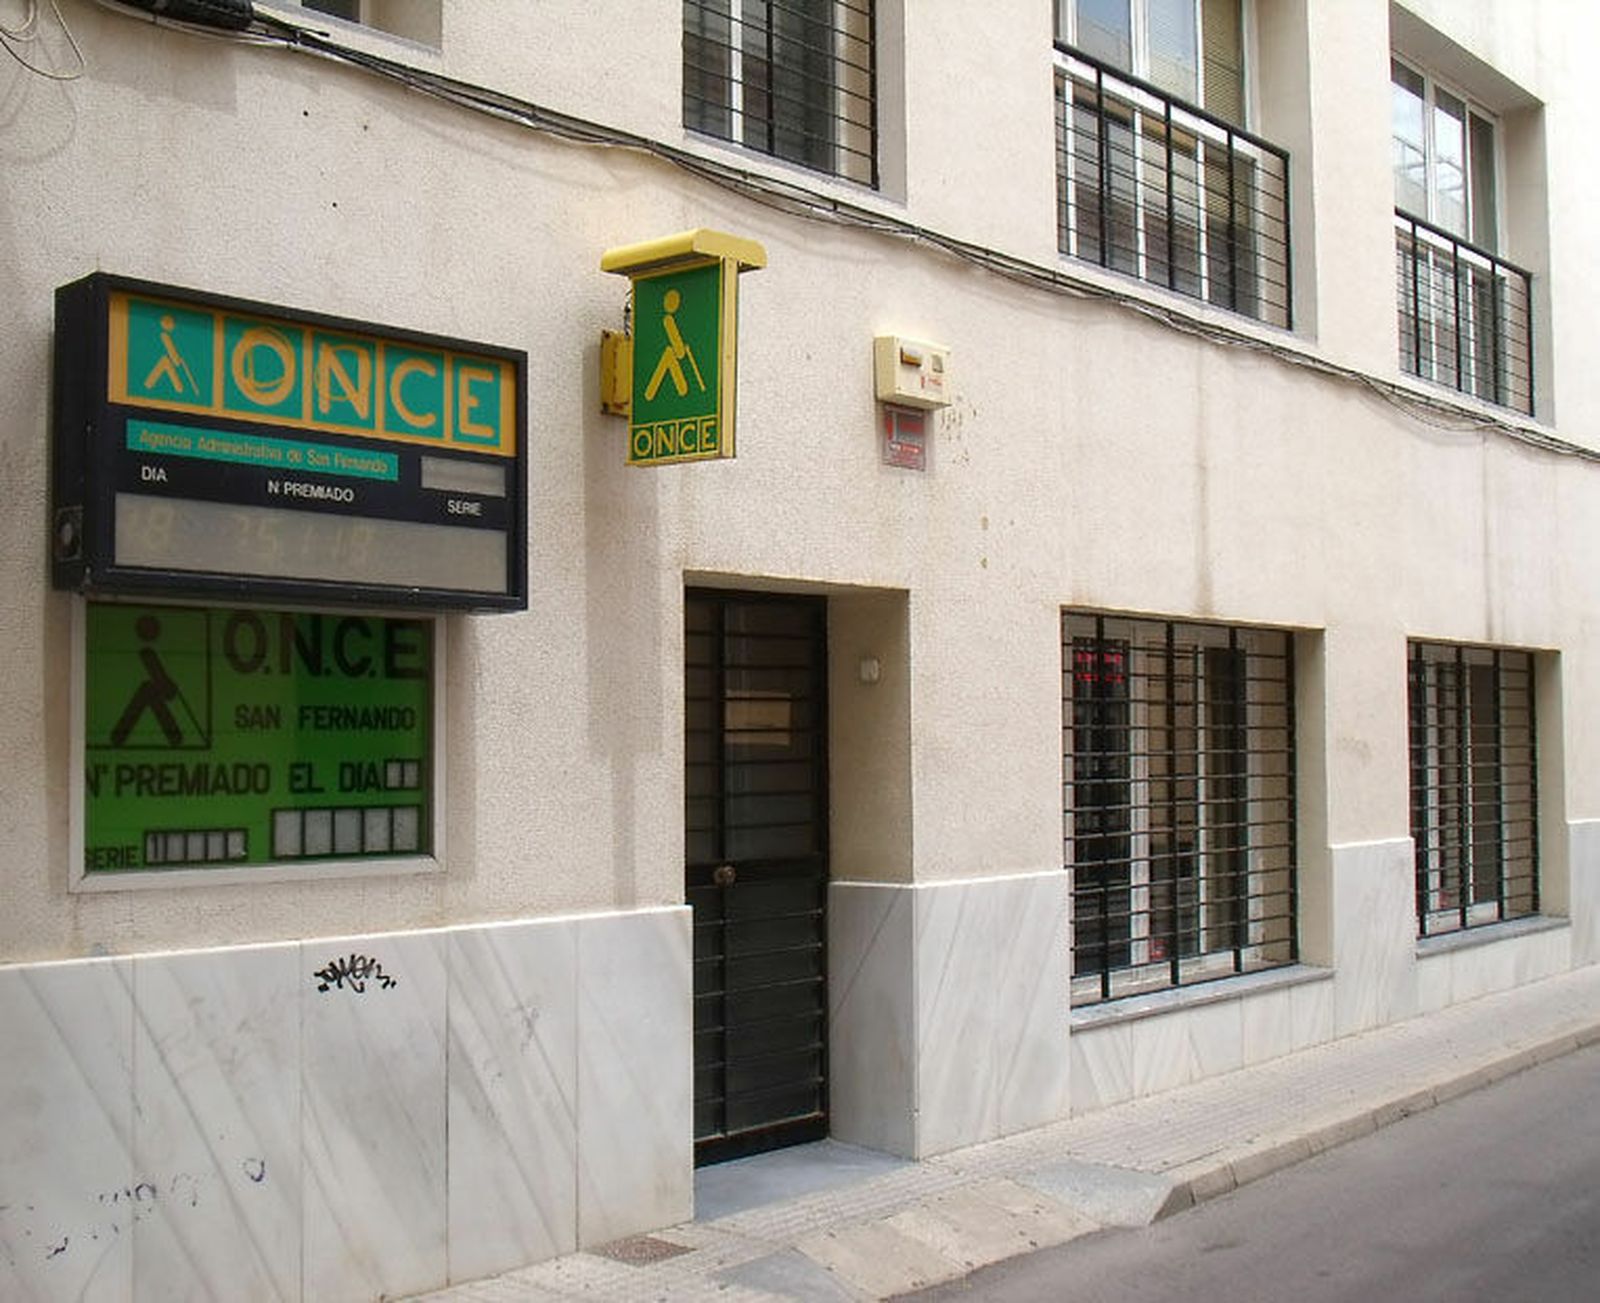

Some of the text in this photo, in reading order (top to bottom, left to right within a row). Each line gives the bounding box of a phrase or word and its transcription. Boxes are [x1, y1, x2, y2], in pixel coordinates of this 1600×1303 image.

[231, 326, 494, 438] ONCE
[634, 420, 716, 457] ONCE
[141, 465, 168, 482] DIA
[283, 481, 355, 502] PREMIADO
[447, 499, 482, 517] SERIE
[234, 704, 416, 731] SAN FERNANDO
[115, 763, 270, 797] PREMIADO
[288, 763, 325, 794] EL
[338, 763, 386, 793] DIA
